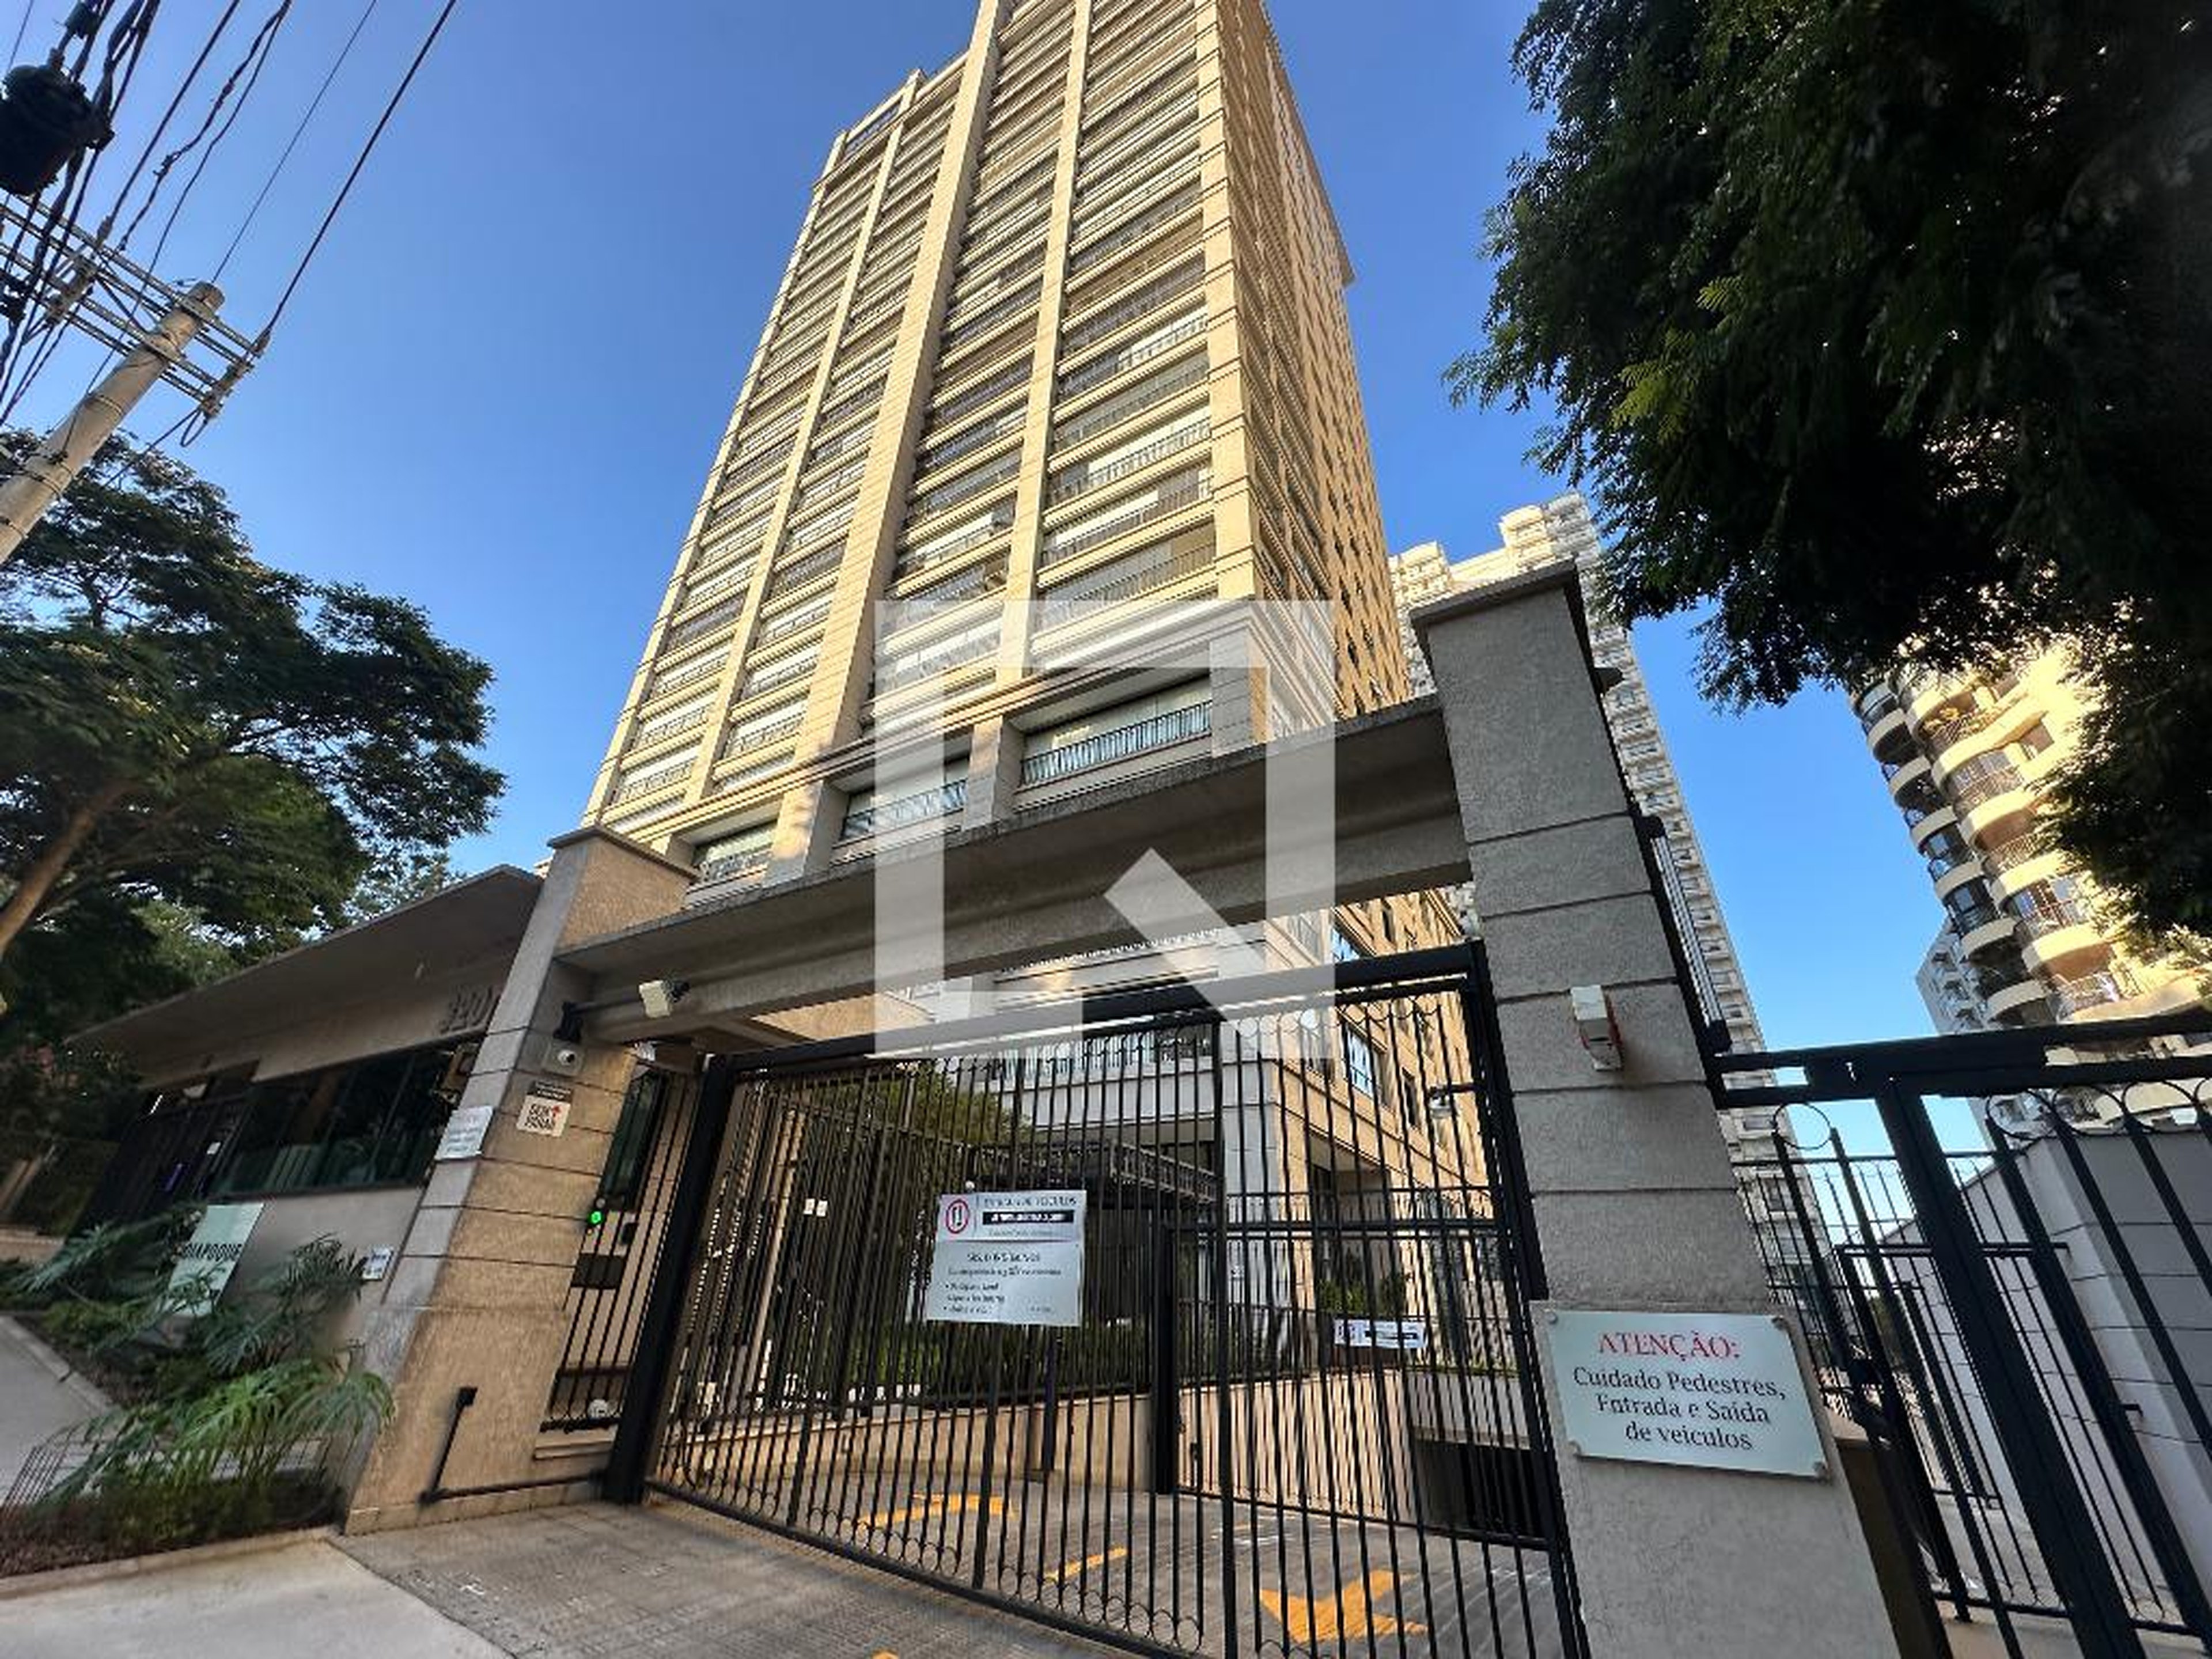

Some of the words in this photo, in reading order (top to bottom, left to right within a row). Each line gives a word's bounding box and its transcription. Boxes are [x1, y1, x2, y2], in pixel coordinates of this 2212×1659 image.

[1599, 1330, 1740, 1361] ATENÇÃO:
[1573, 1366, 1660, 1390] Cuidado
[1667, 1372, 1786, 1400] Pedestres,
[1595, 1393, 1680, 1418] Entrada
[1688, 1405, 1699, 1418] e
[1625, 1421, 1652, 1442] de
